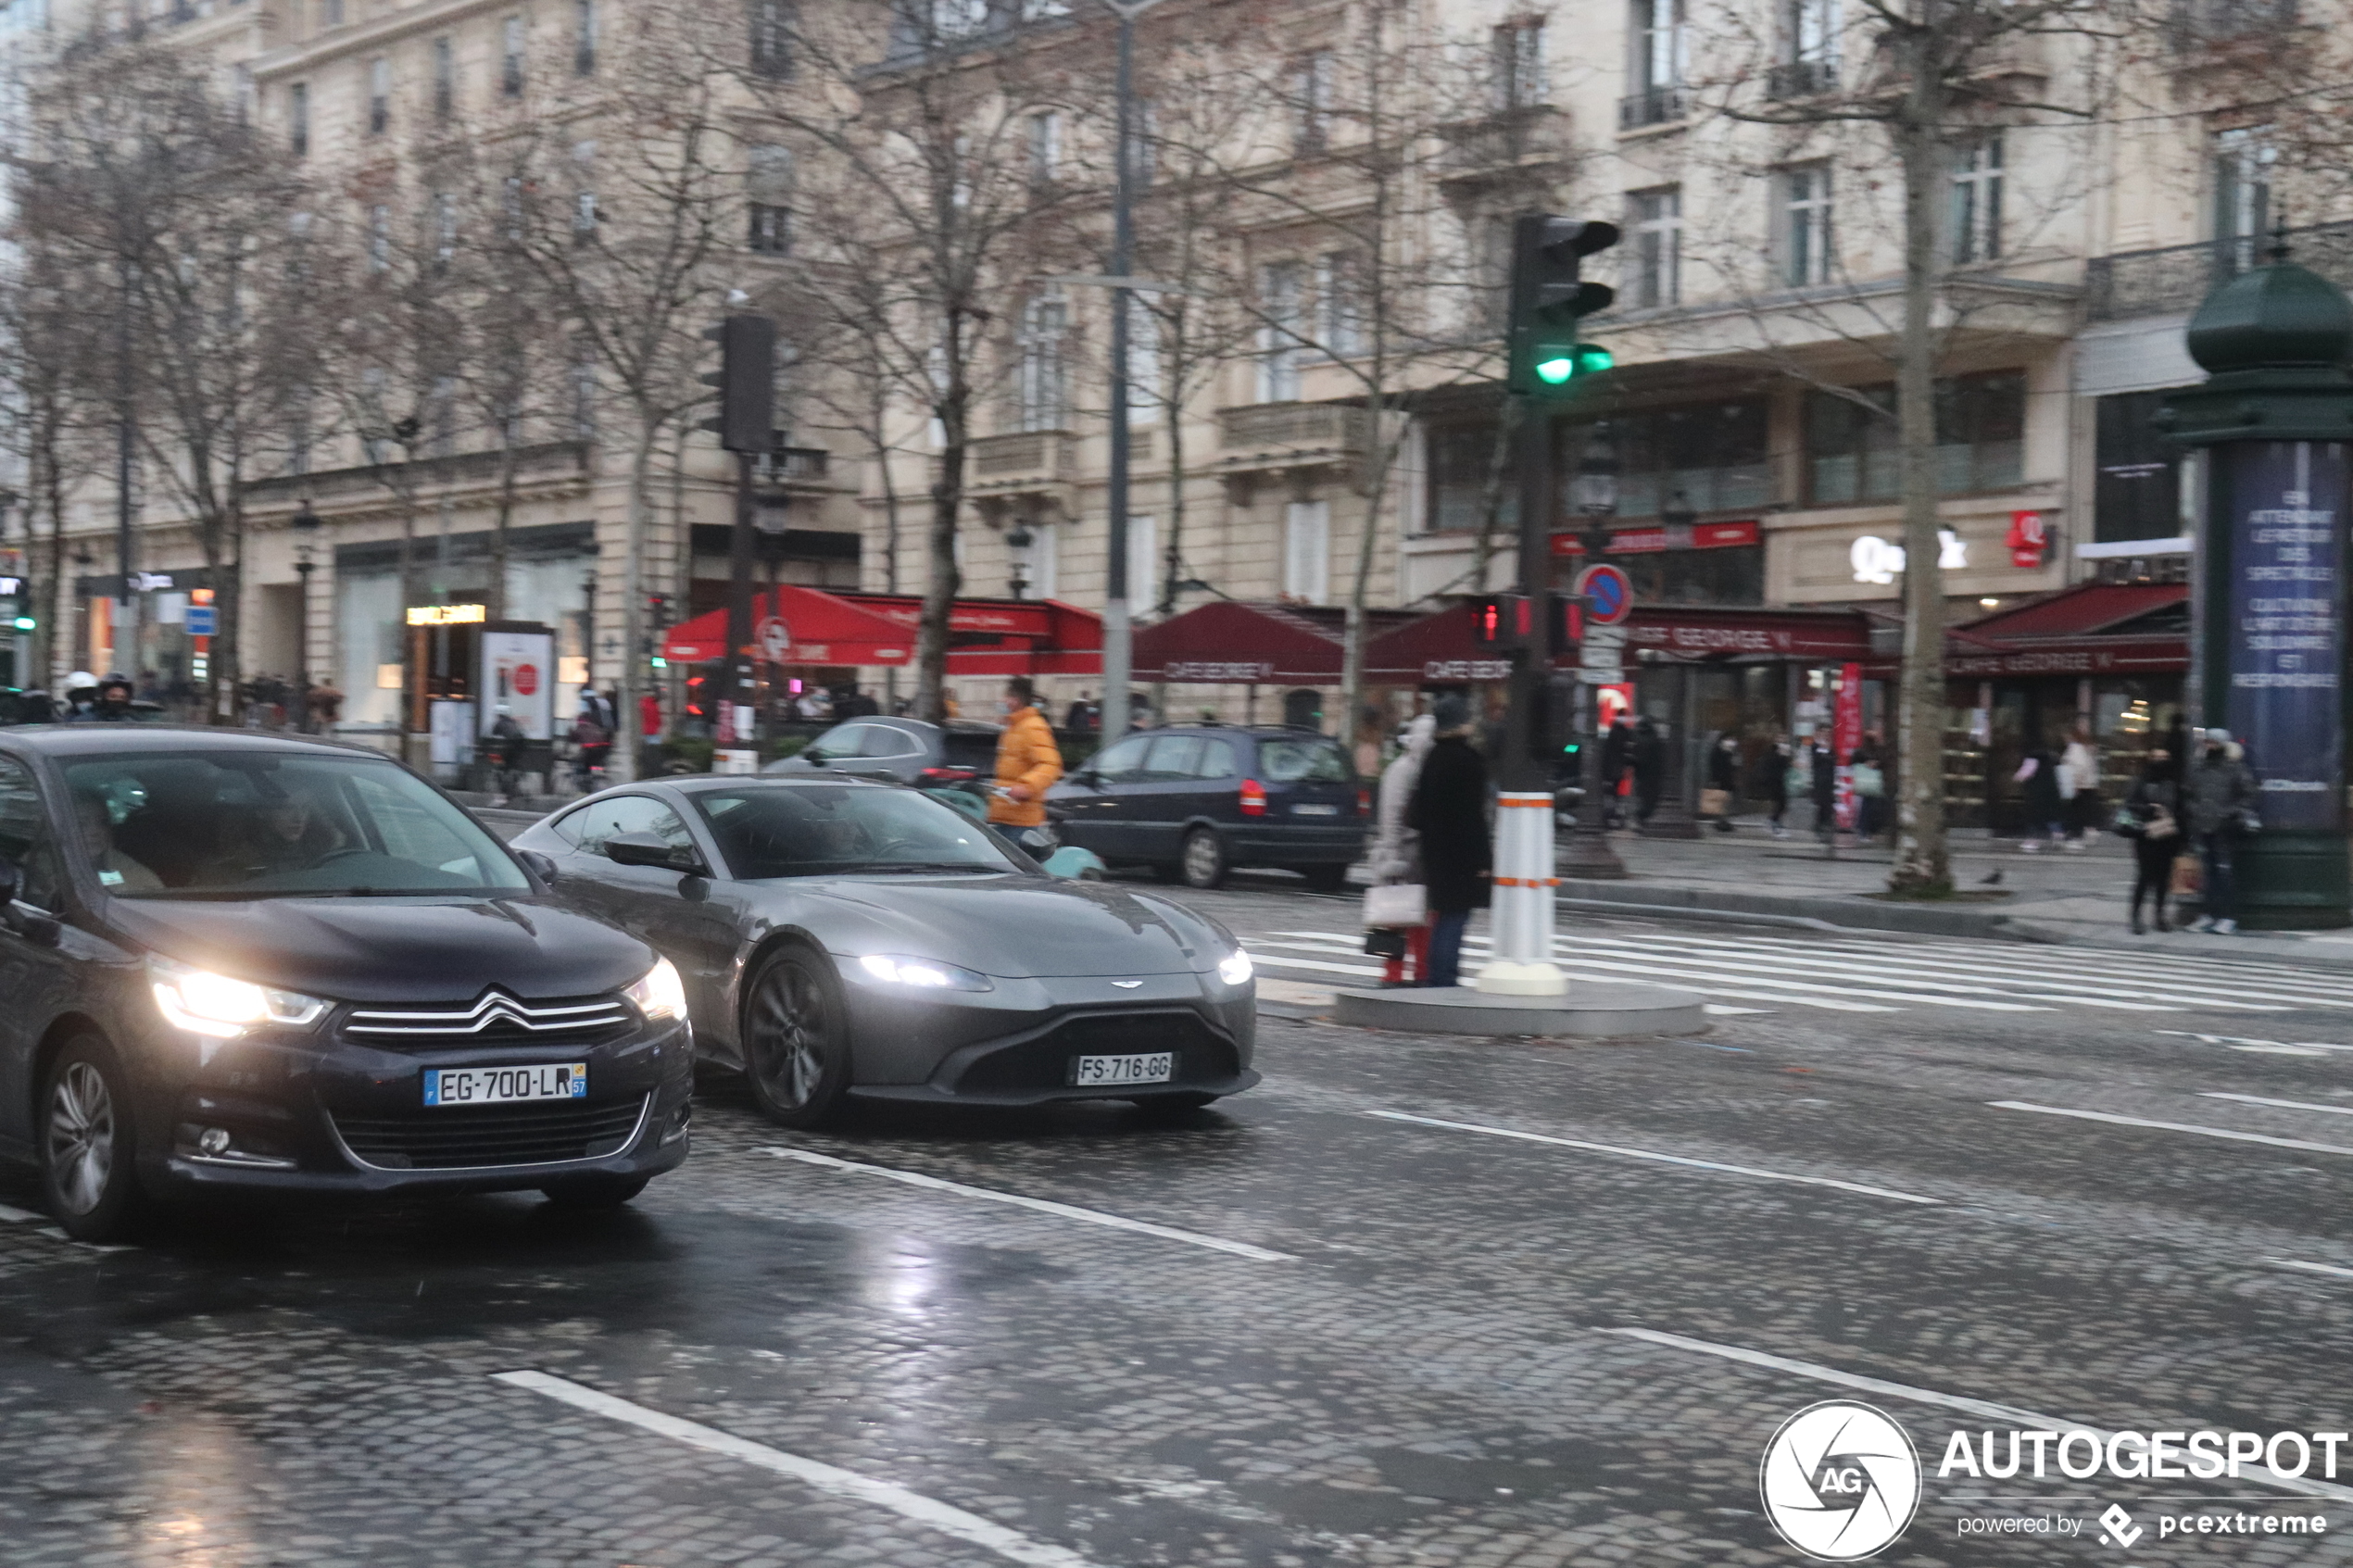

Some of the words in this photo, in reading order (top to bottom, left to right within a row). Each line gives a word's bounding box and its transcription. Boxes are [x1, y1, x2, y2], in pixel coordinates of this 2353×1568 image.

[1672, 627, 1773, 648] GEORGE
[2004, 652, 2093, 671] GEORGE
[1081, 1057, 1168, 1078] FS-716-GG
[441, 1068, 570, 1101] EG-700-LR
[573, 1081, 585, 1093] 57
